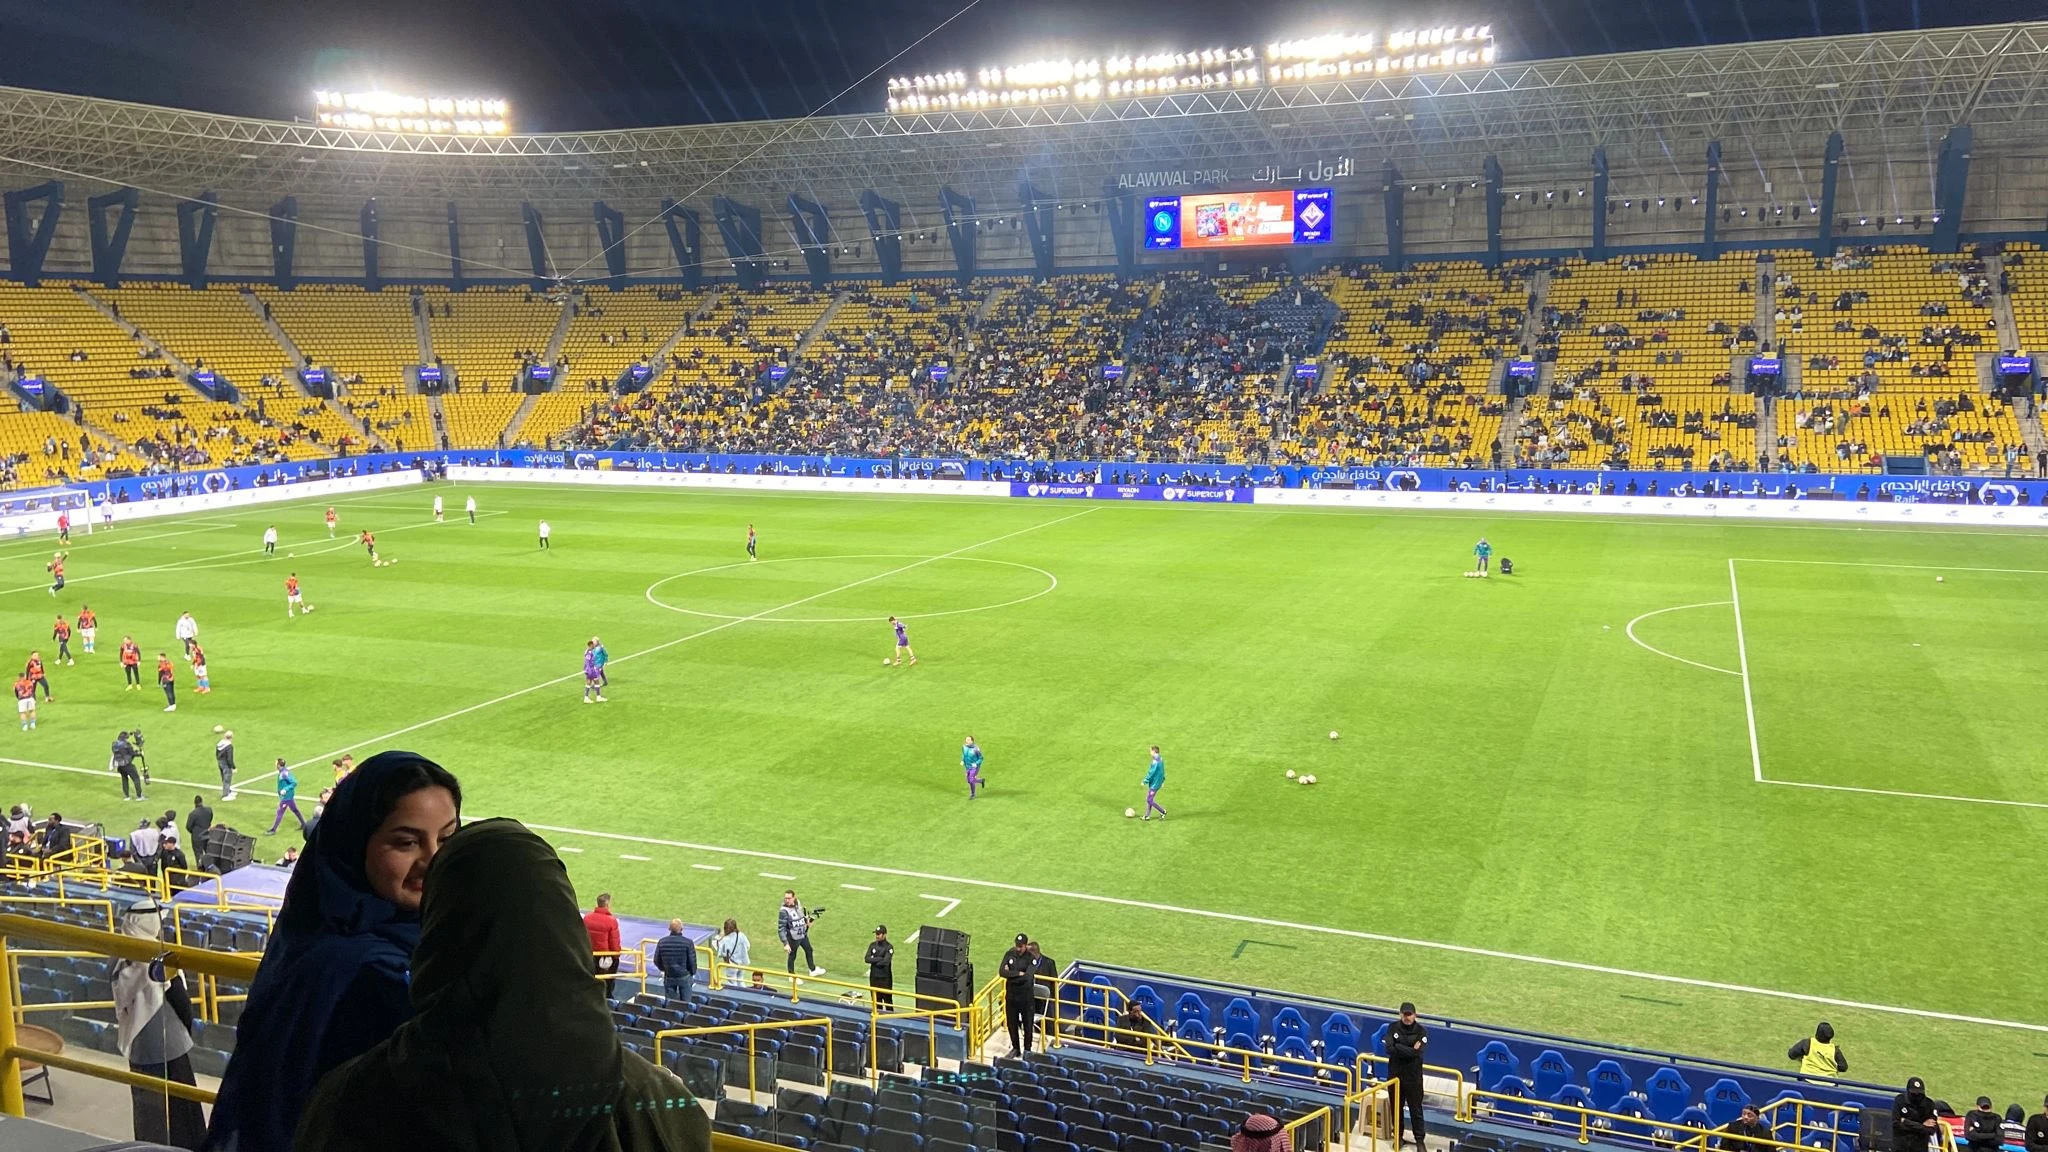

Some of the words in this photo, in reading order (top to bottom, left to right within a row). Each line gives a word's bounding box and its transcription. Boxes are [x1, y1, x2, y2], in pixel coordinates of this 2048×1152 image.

[1252, 165, 1302, 184] بارك
[1309, 156, 1355, 181] الأول
[1119, 170, 1190, 188] ALAWWAL
[1194, 169, 1230, 184] PARK
